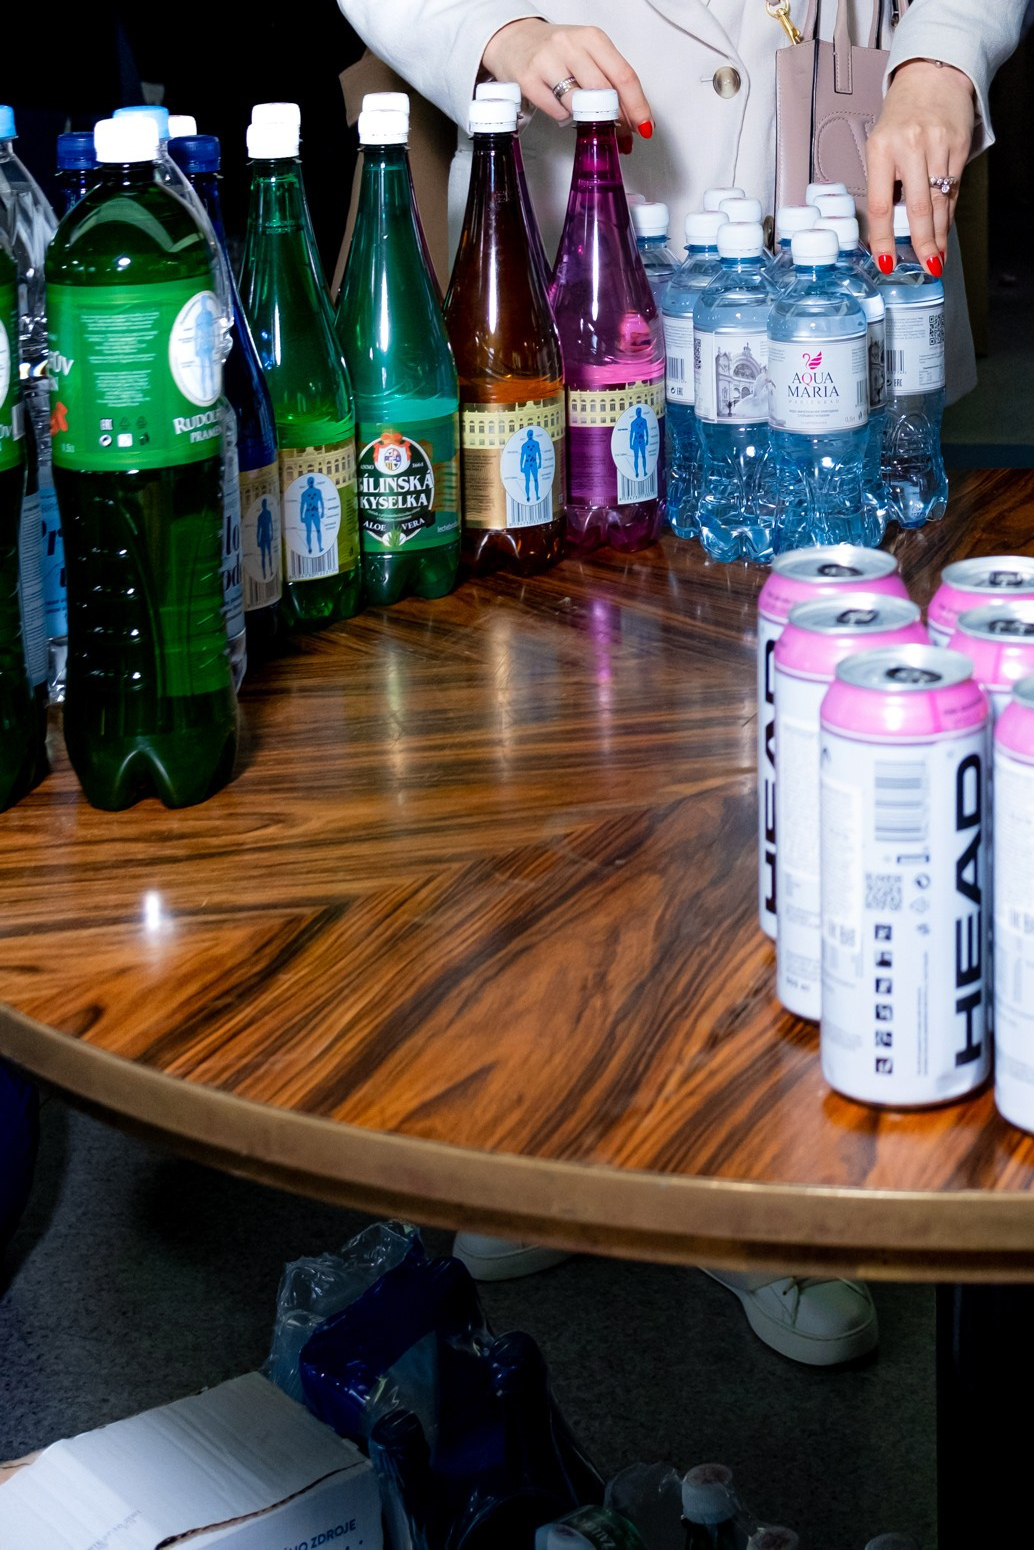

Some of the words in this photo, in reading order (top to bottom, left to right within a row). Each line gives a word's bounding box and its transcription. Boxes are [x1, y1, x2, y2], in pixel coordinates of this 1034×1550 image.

[792, 372, 834, 387] AQUA
[787, 385, 840, 398] MARIA
[360, 493, 428, 509] KYSELKA
[363, 520, 386, 531] ALOE
[401, 517, 425, 530] VERA
[955, 753, 983, 1068] HEAD
[310, 1518, 356, 1549] ZDROJE
